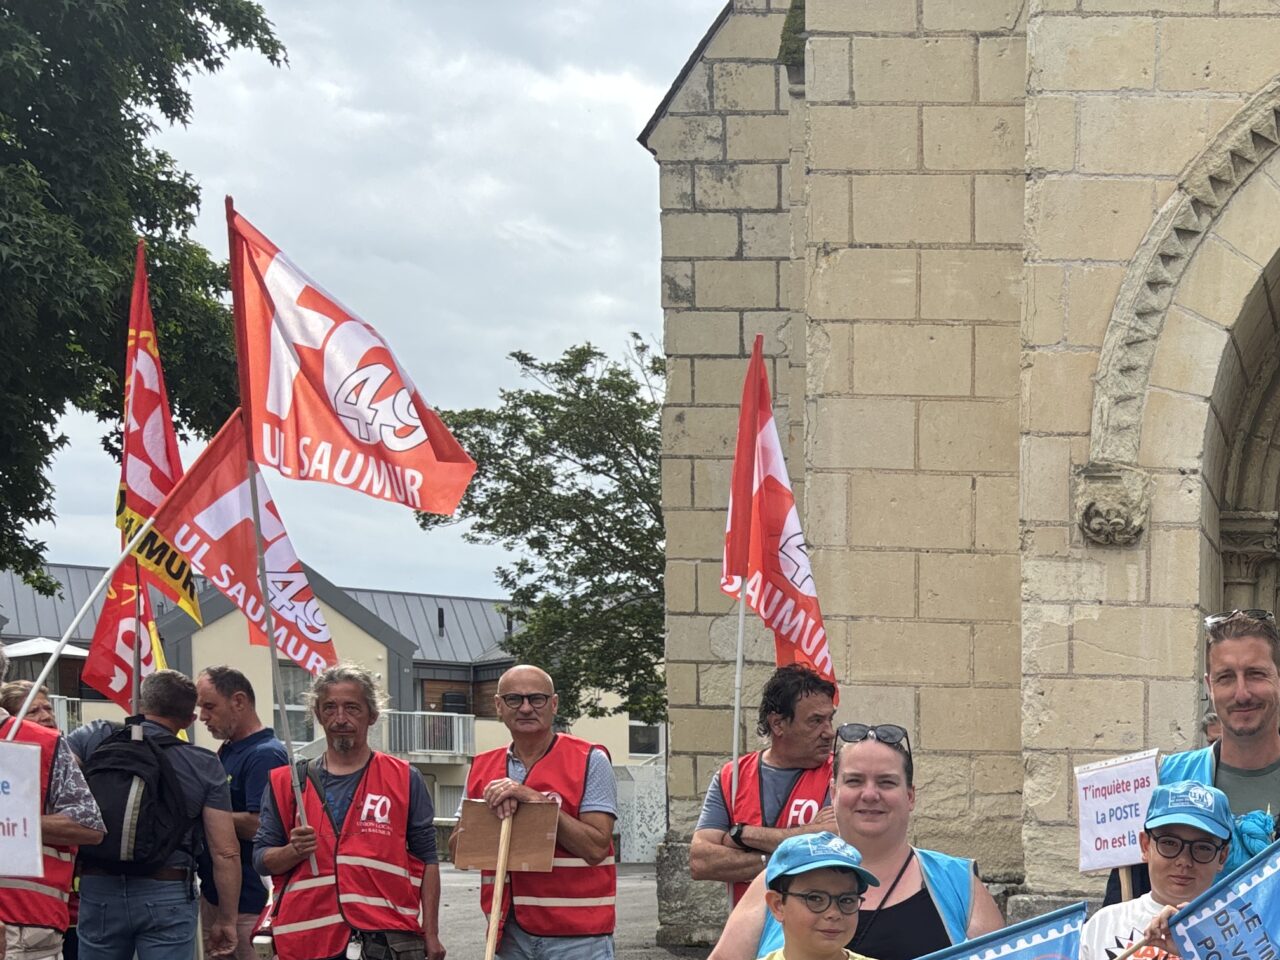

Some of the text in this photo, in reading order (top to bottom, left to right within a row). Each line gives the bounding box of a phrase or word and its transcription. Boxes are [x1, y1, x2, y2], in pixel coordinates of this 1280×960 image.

[334, 363, 428, 452] 49
[262, 422, 423, 508] UL SAUMUR
[174, 523, 210, 571] UL
[211, 563, 327, 676] SAUMUR
[1134, 775, 1151, 793] pas
[360, 793, 391, 824] FO
[787, 799, 819, 829] FO
[1096, 803, 1140, 825] La POSTE
[1095, 830, 1137, 851] On est là
[1214, 909, 1239, 941] DE
[1238, 902, 1262, 933] LE
